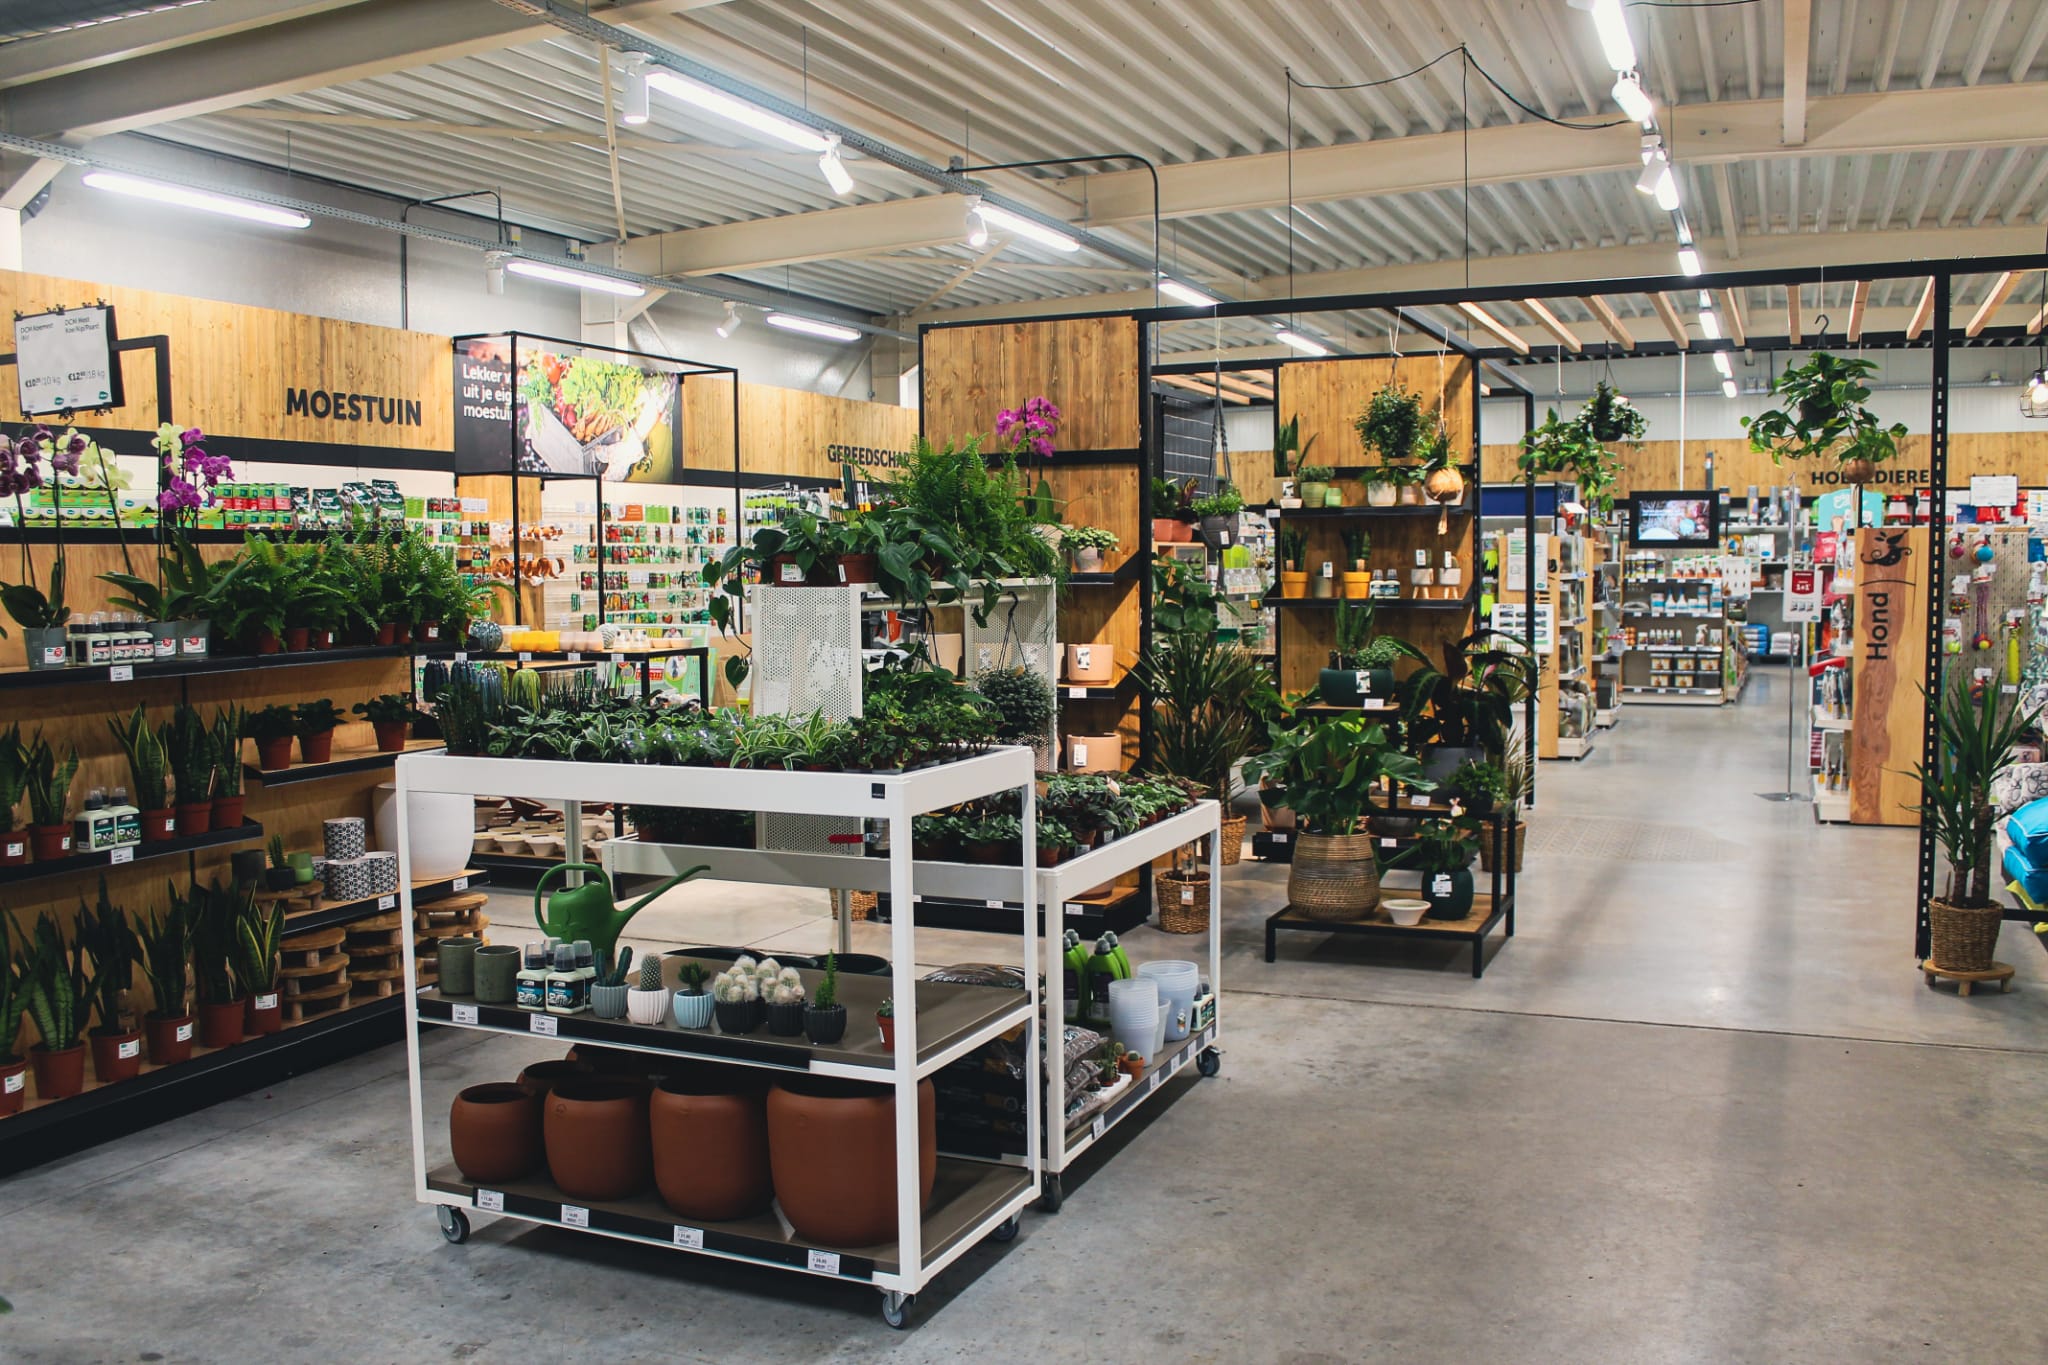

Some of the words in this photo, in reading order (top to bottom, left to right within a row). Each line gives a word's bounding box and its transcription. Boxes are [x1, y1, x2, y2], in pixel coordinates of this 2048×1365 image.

[463, 363, 502, 383] Lekker
[504, 372, 528, 386] vrs
[463, 383, 480, 399] uit
[481, 384, 493, 403] je
[495, 387, 527, 406] eign
[286, 387, 422, 427] MOESTUIN
[463, 405, 513, 421] moestui
[1866, 592, 1889, 660] Hond
